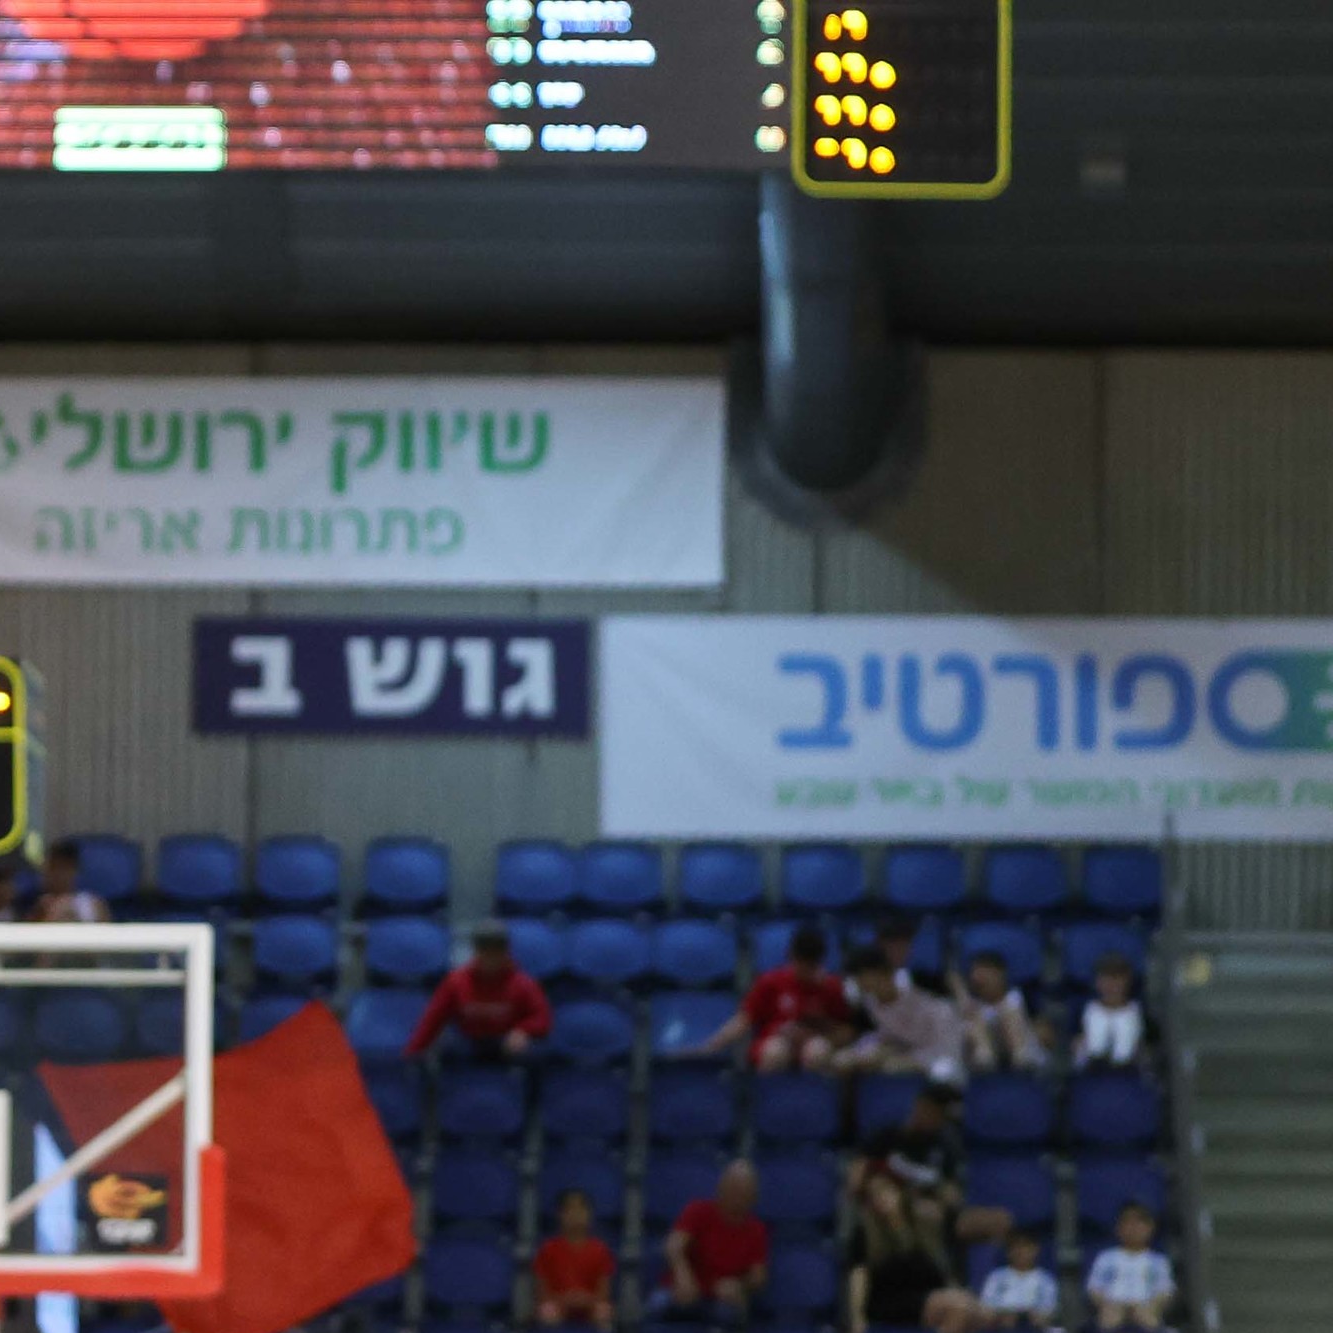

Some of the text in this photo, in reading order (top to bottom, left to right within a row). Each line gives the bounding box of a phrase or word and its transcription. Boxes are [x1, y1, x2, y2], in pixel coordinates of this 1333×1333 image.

[331, 410, 550, 495] שיווק
[229, 634, 557, 720] גוש ב
